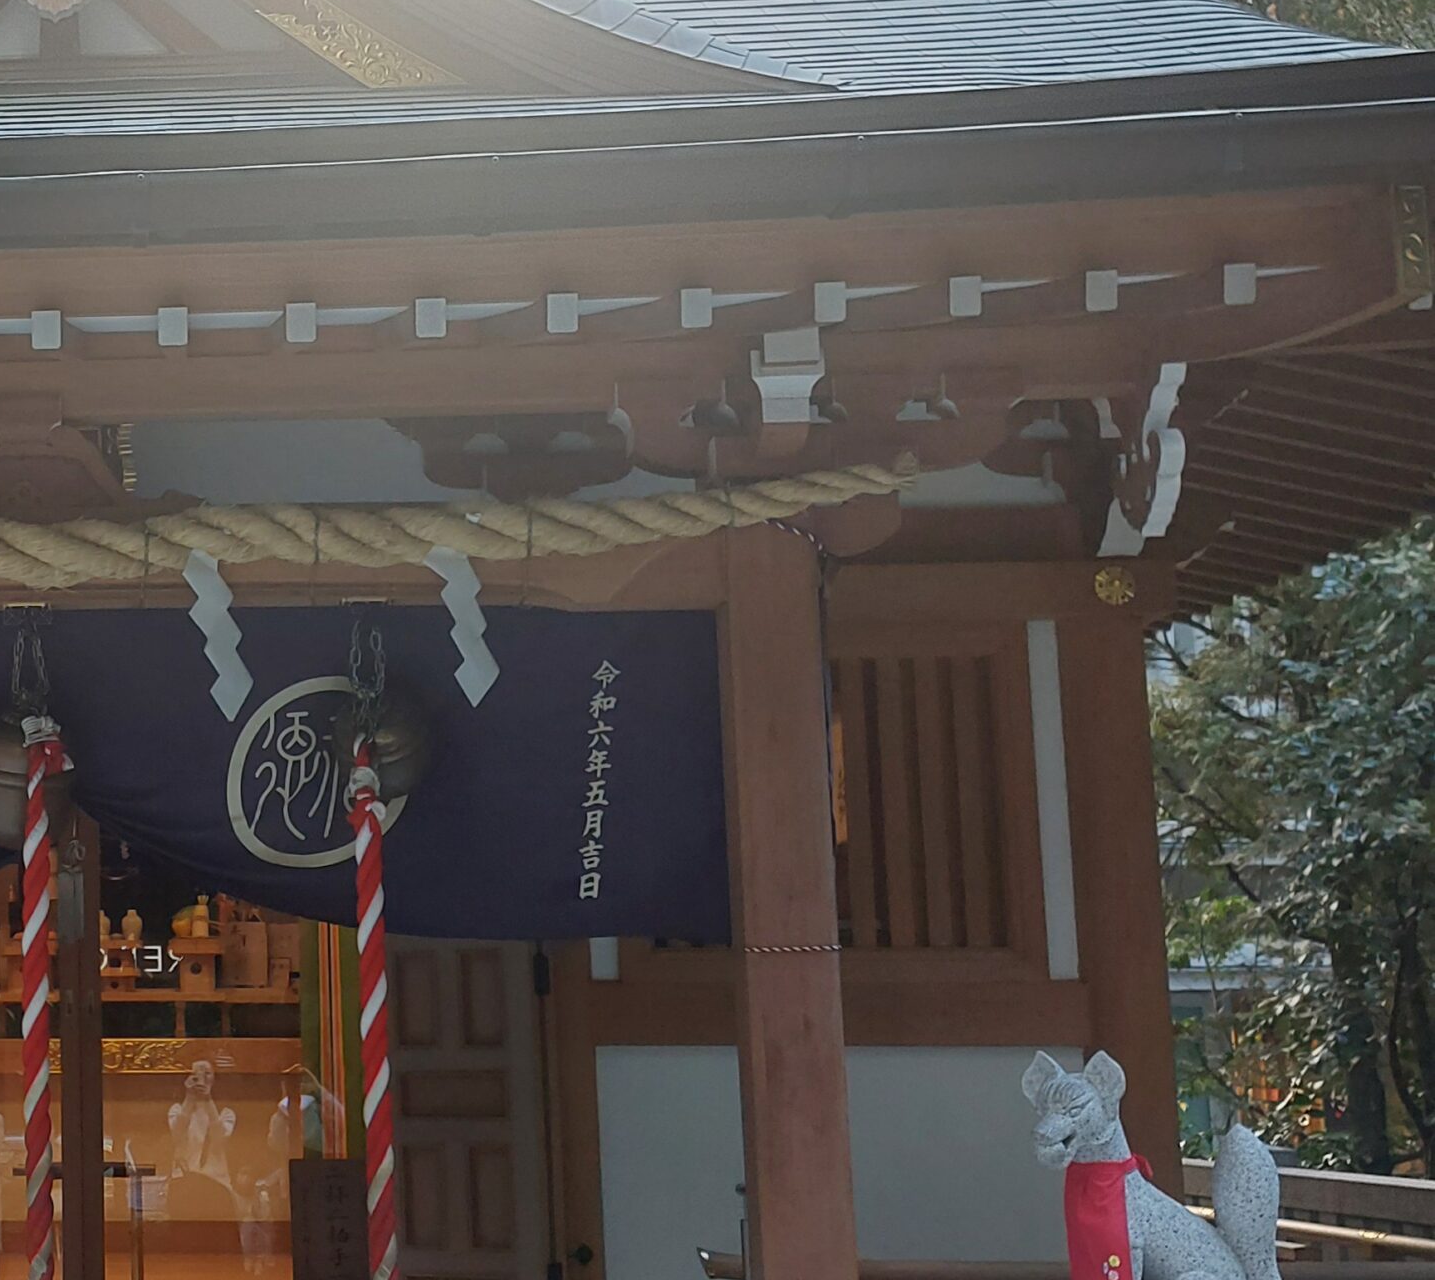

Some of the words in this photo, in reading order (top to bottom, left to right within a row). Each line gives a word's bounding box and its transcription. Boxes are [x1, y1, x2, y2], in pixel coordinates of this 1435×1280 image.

[576, 660, 619, 899] 令和六年五月吉日
